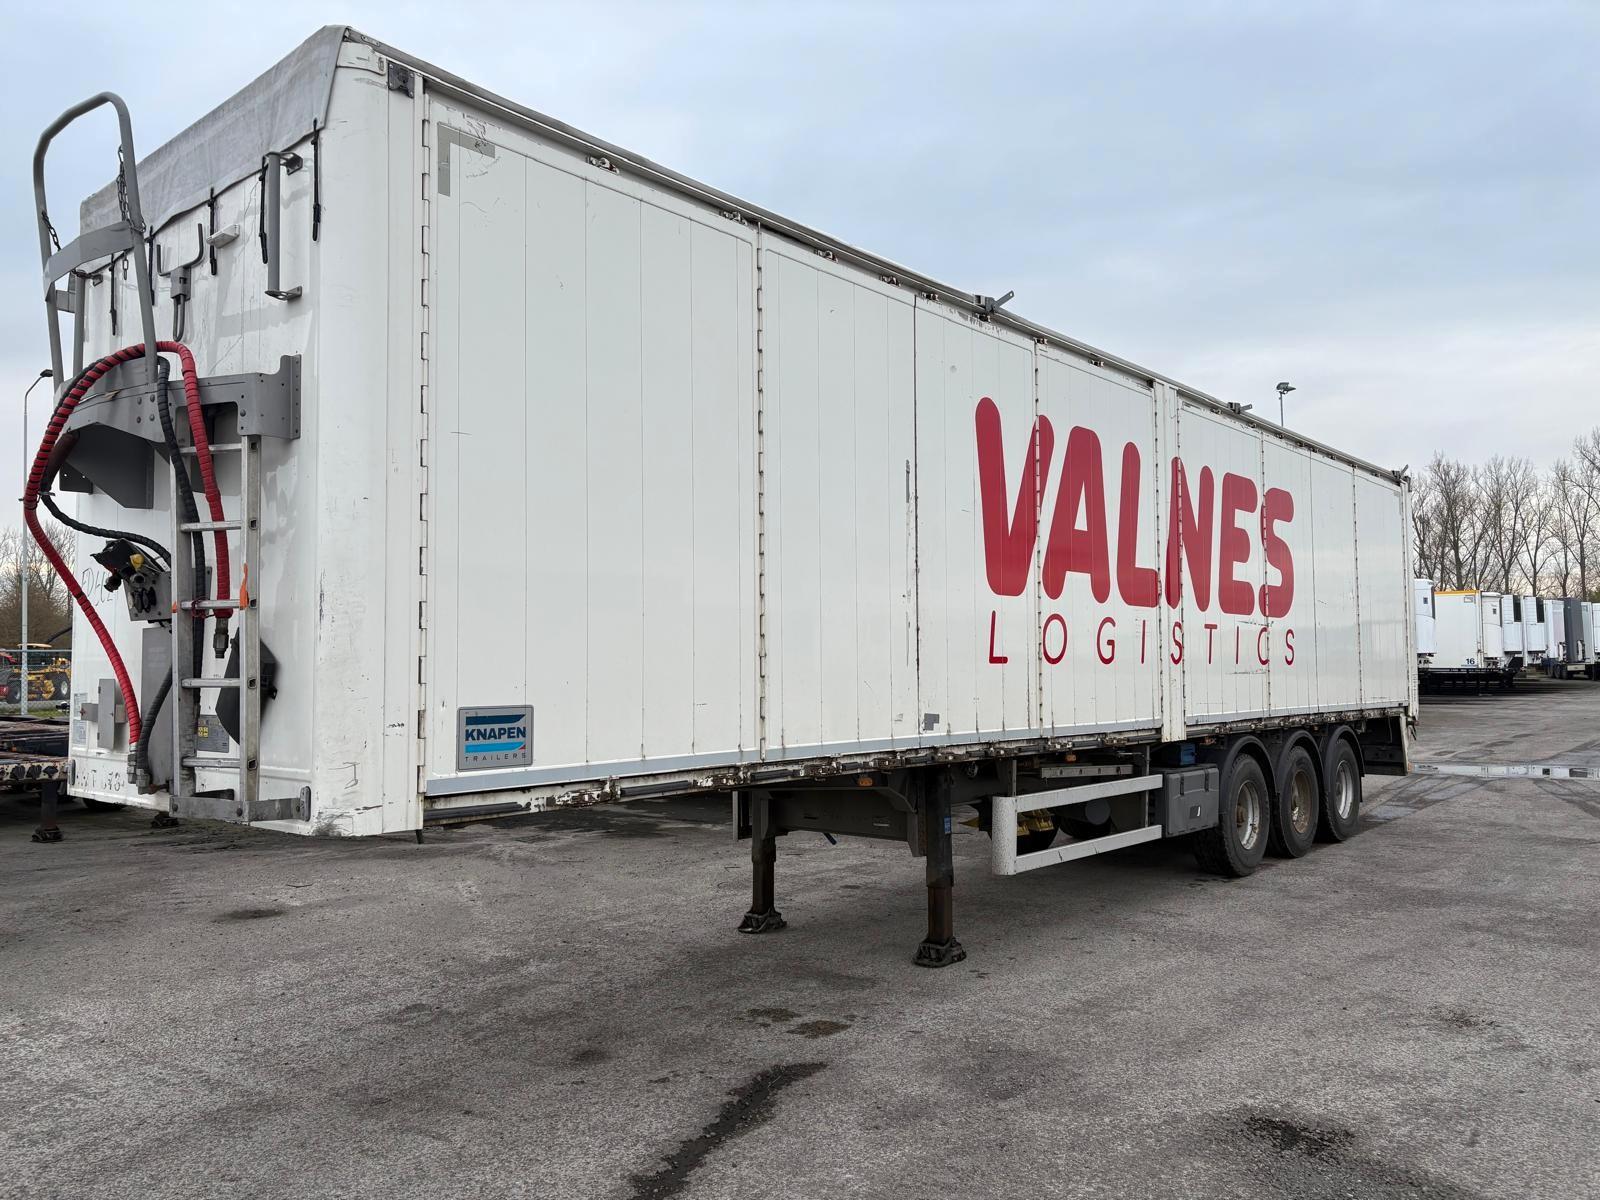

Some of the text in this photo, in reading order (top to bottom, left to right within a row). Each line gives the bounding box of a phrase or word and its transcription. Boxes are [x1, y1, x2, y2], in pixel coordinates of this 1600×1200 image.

[975, 396, 1295, 618] VALNES
[988, 610, 1296, 665] LOGISTICS
[1466, 657, 1475, 665] 16
[465, 726, 526, 741] KNAPEN
[465, 752, 526, 762] TRAILERS
